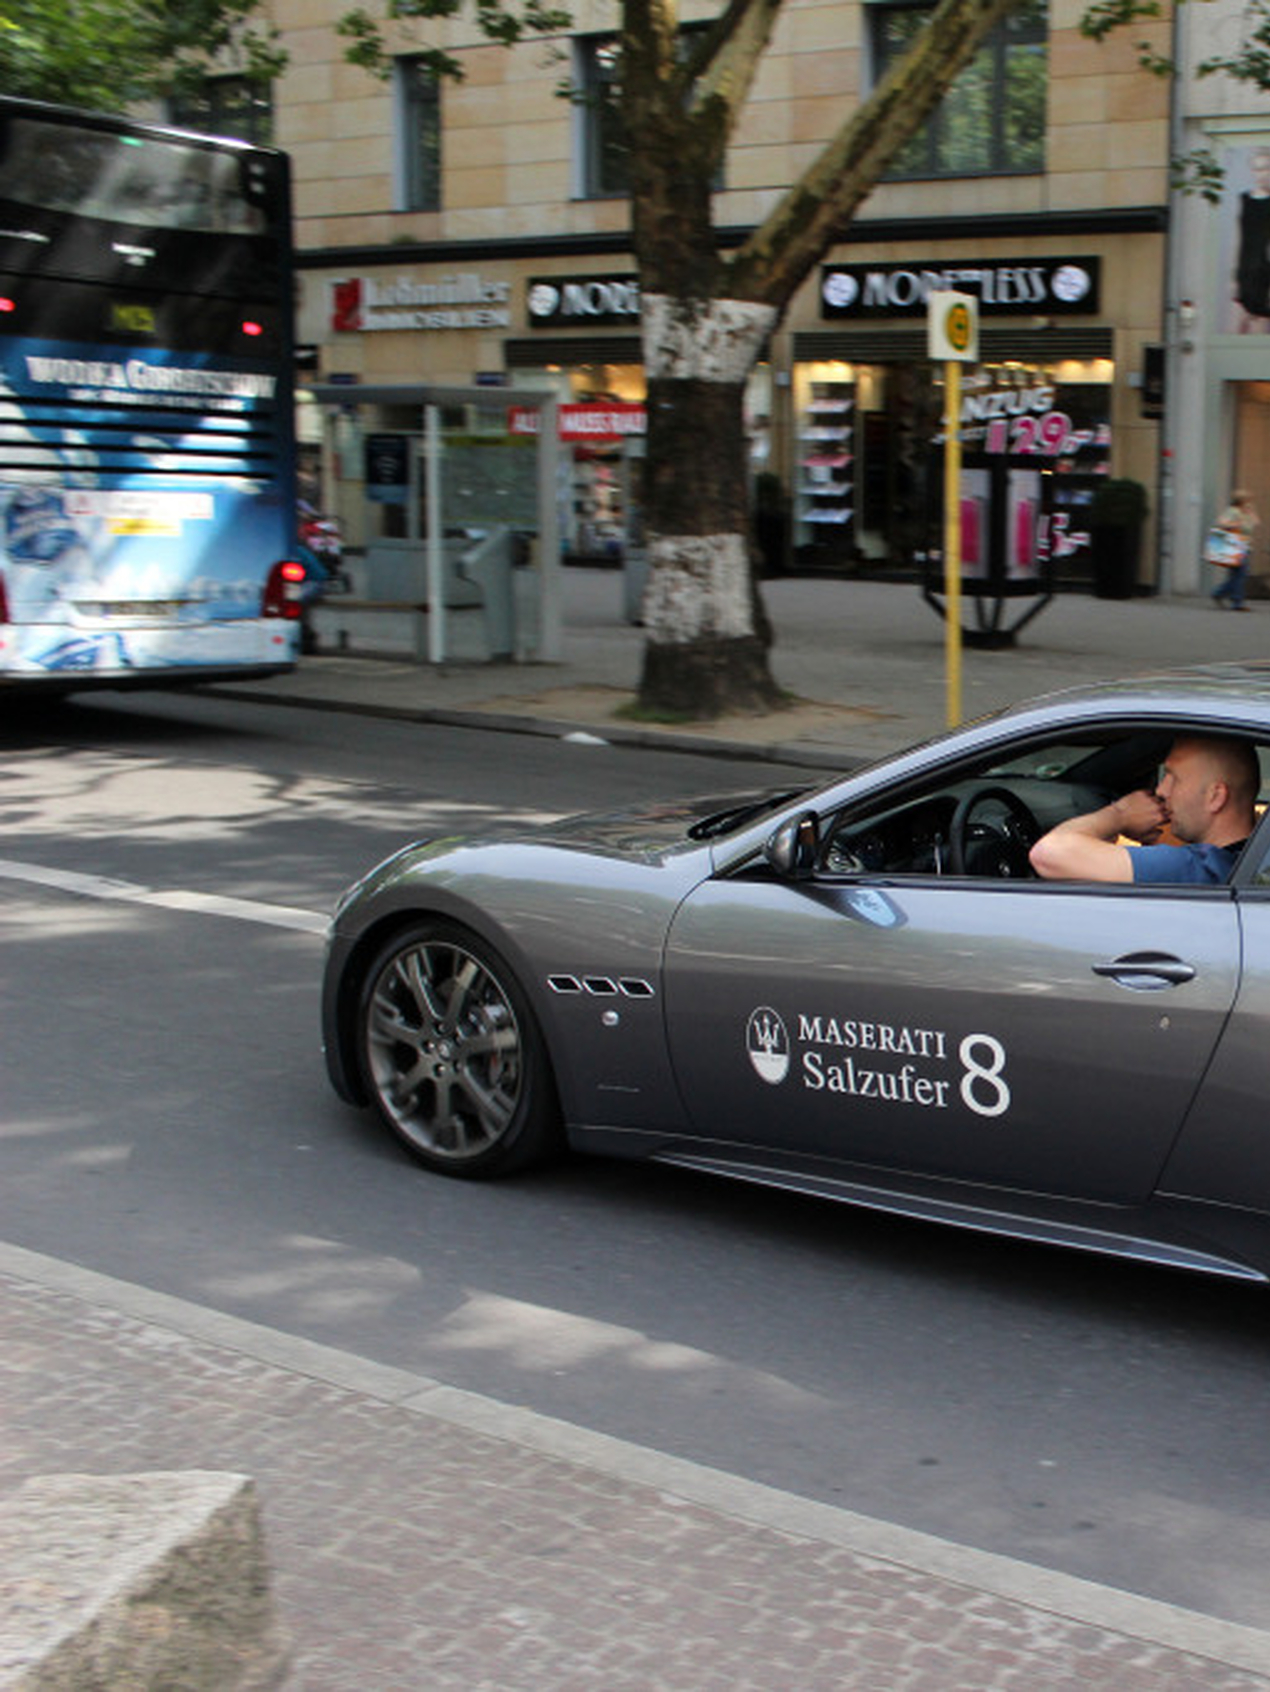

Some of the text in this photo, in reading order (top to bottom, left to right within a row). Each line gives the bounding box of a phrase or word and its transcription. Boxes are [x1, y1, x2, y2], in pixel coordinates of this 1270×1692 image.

[941, 386, 1056, 425] NZUG
[797, 1014, 947, 1060] MASERATI
[802, 1032, 1011, 1118] Salzufer 8
